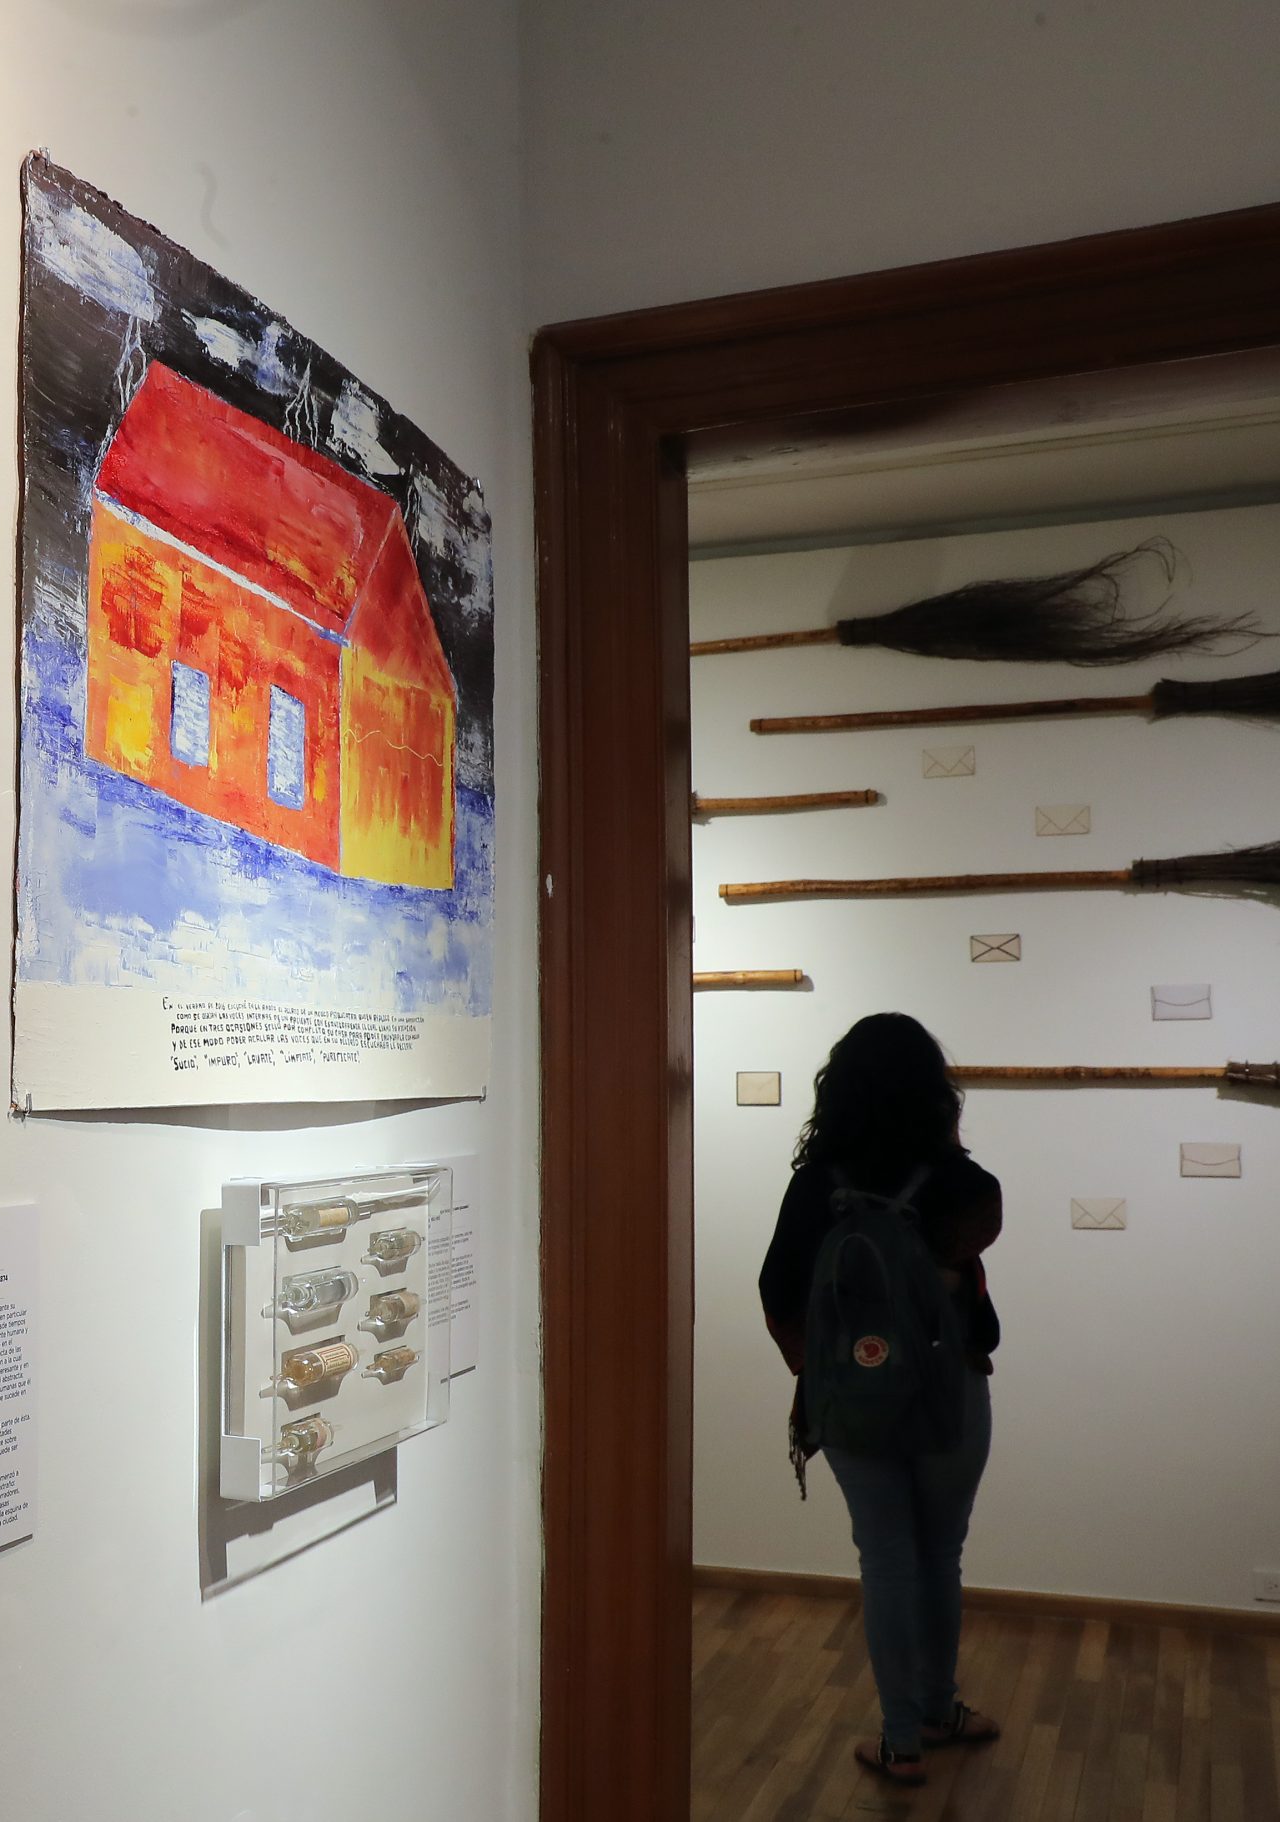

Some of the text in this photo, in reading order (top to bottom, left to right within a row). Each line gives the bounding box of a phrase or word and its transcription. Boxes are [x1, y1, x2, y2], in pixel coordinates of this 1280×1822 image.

[171, 1023, 197, 1034] PORQUE
[209, 1024, 223, 1032] TRES
[226, 1023, 262, 1033] OCASIONES
[190, 1039, 201, 1048] ESE
[204, 1037, 224, 1047] MODO
[227, 1036, 246, 1044] PODER
[277, 1035, 288, 1043] LAS
